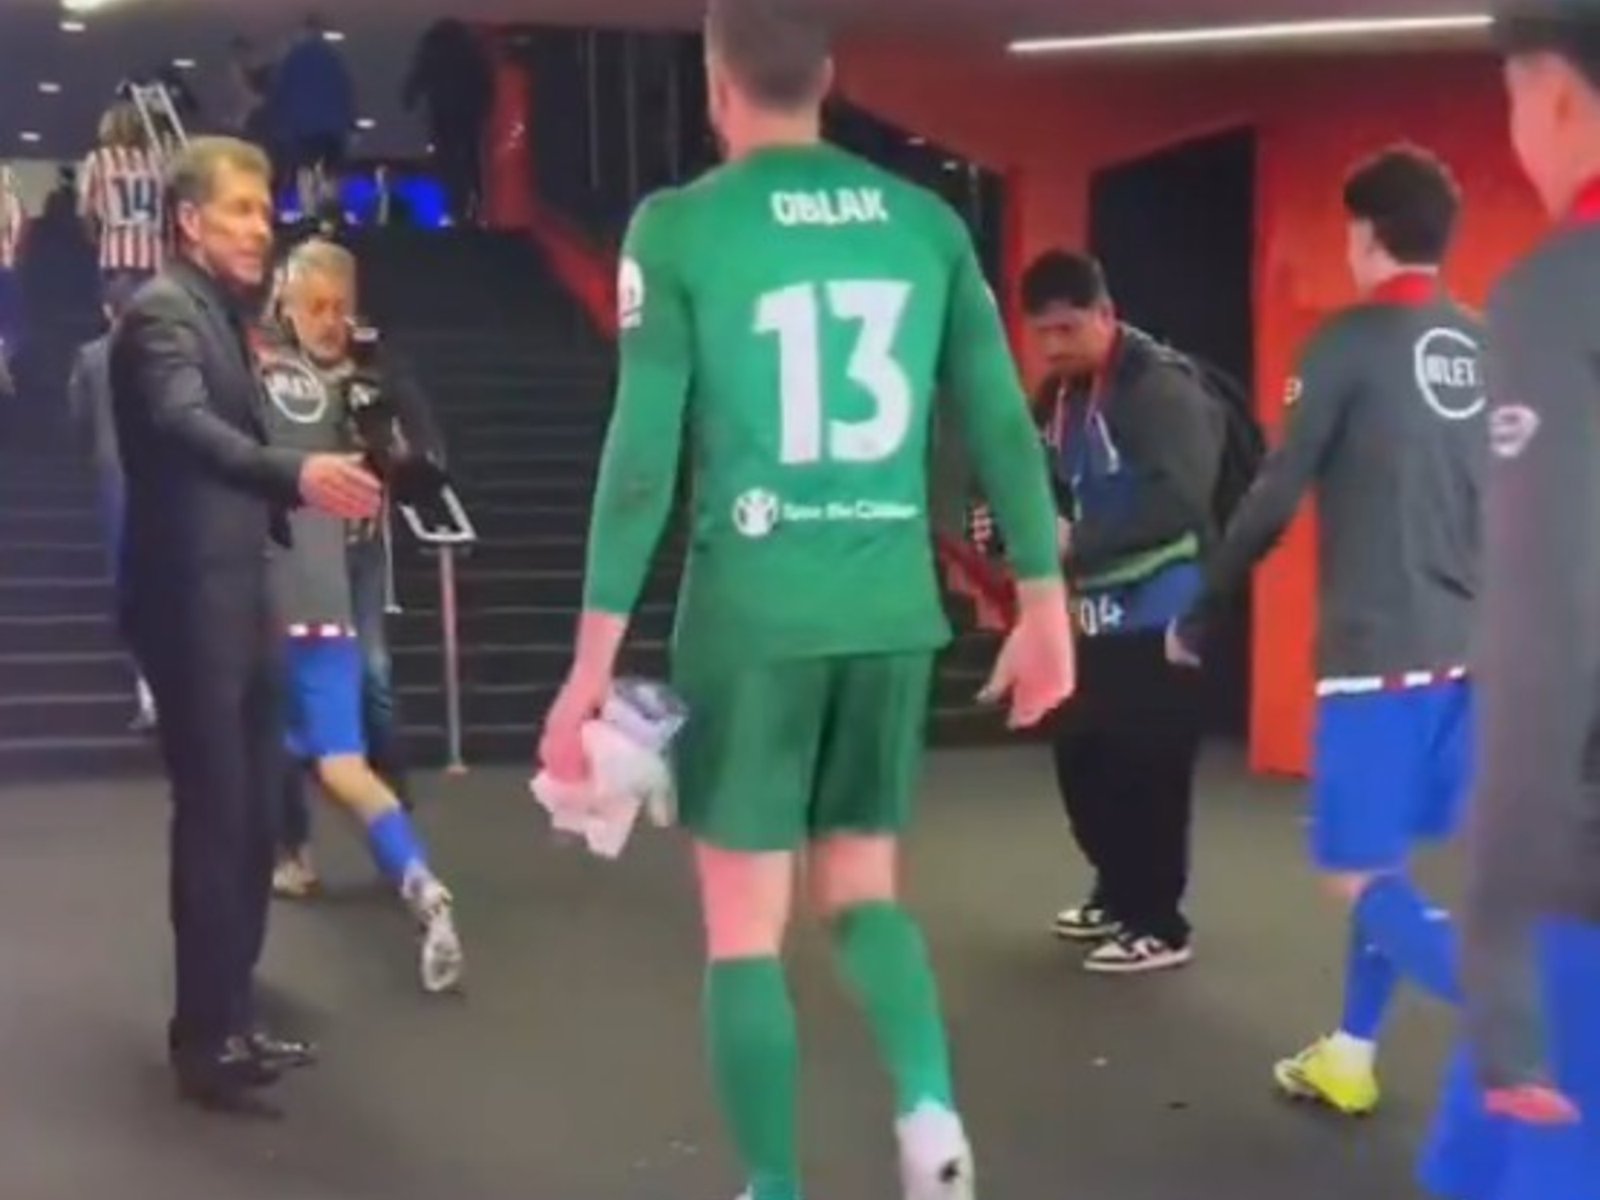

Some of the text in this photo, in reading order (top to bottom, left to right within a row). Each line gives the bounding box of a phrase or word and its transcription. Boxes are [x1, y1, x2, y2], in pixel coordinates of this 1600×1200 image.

[111, 176, 157, 221] 14
[770, 187, 889, 227] OBLAK
[751, 279, 914, 464] 13
